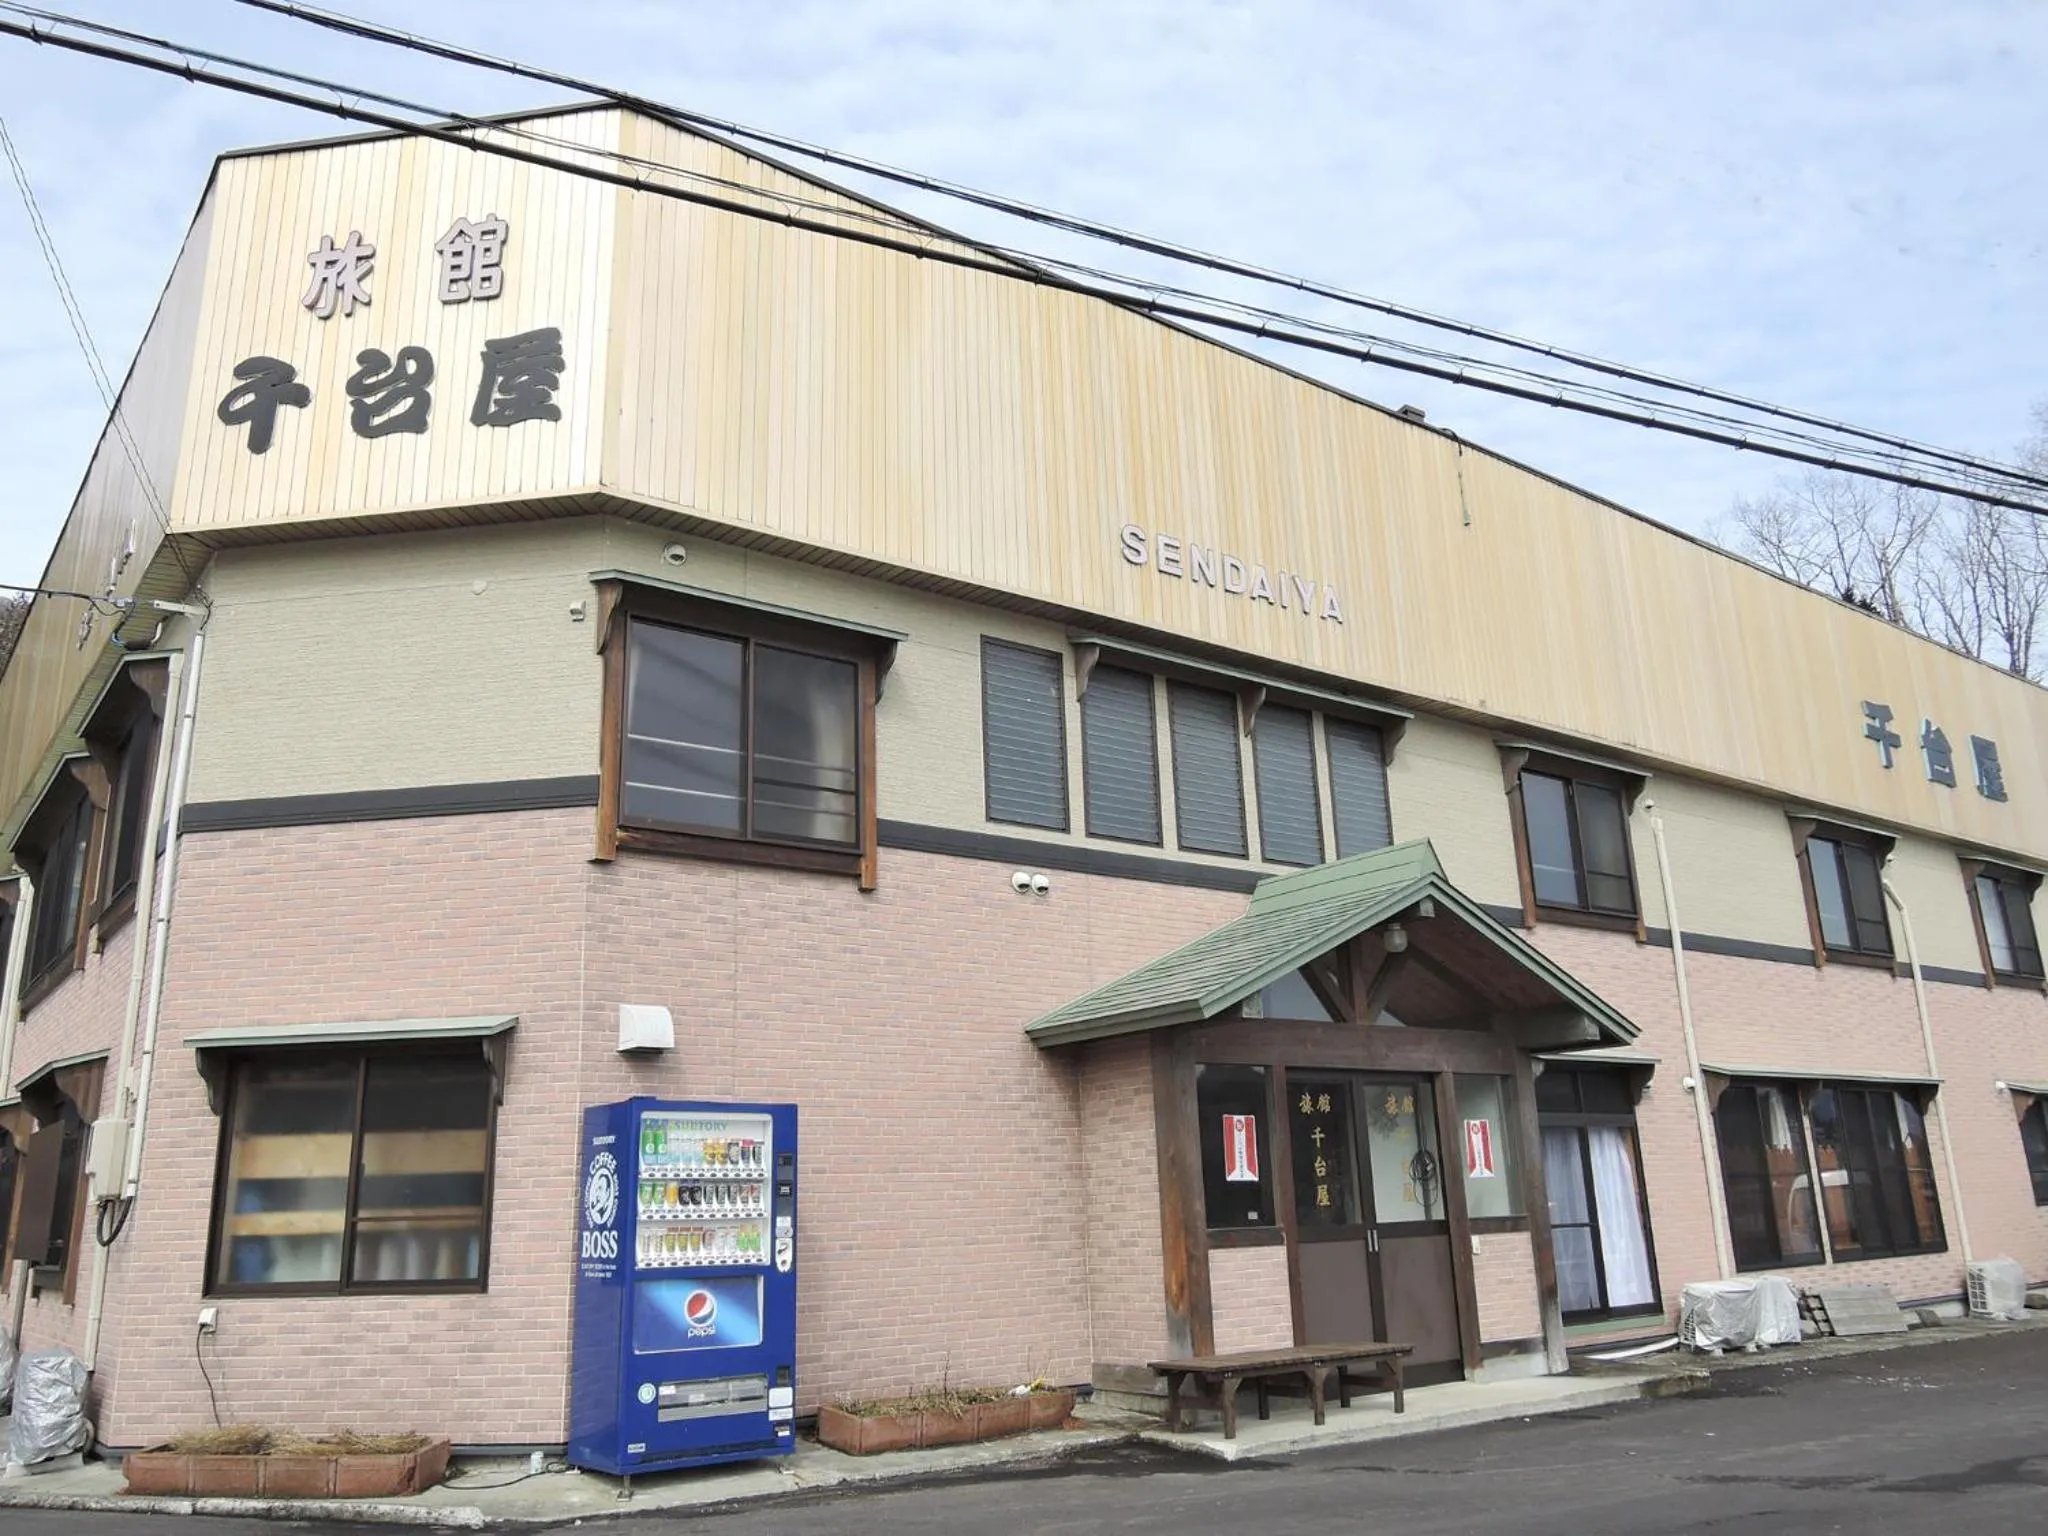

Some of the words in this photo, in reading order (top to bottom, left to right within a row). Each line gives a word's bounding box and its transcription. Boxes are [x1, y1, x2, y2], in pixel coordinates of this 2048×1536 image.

[302, 213, 509, 319] 旅館
[1120, 523, 1344, 624] SENDAIYA
[1861, 700, 2009, 803] 千台屋
[1299, 1092, 1332, 1114] 旅館
[589, 1152, 617, 1175] COFFEE
[1311, 1126, 1332, 1207] 千台屋
[581, 1230, 618, 1259] BOSS
[688, 1324, 716, 1340] pepsi
